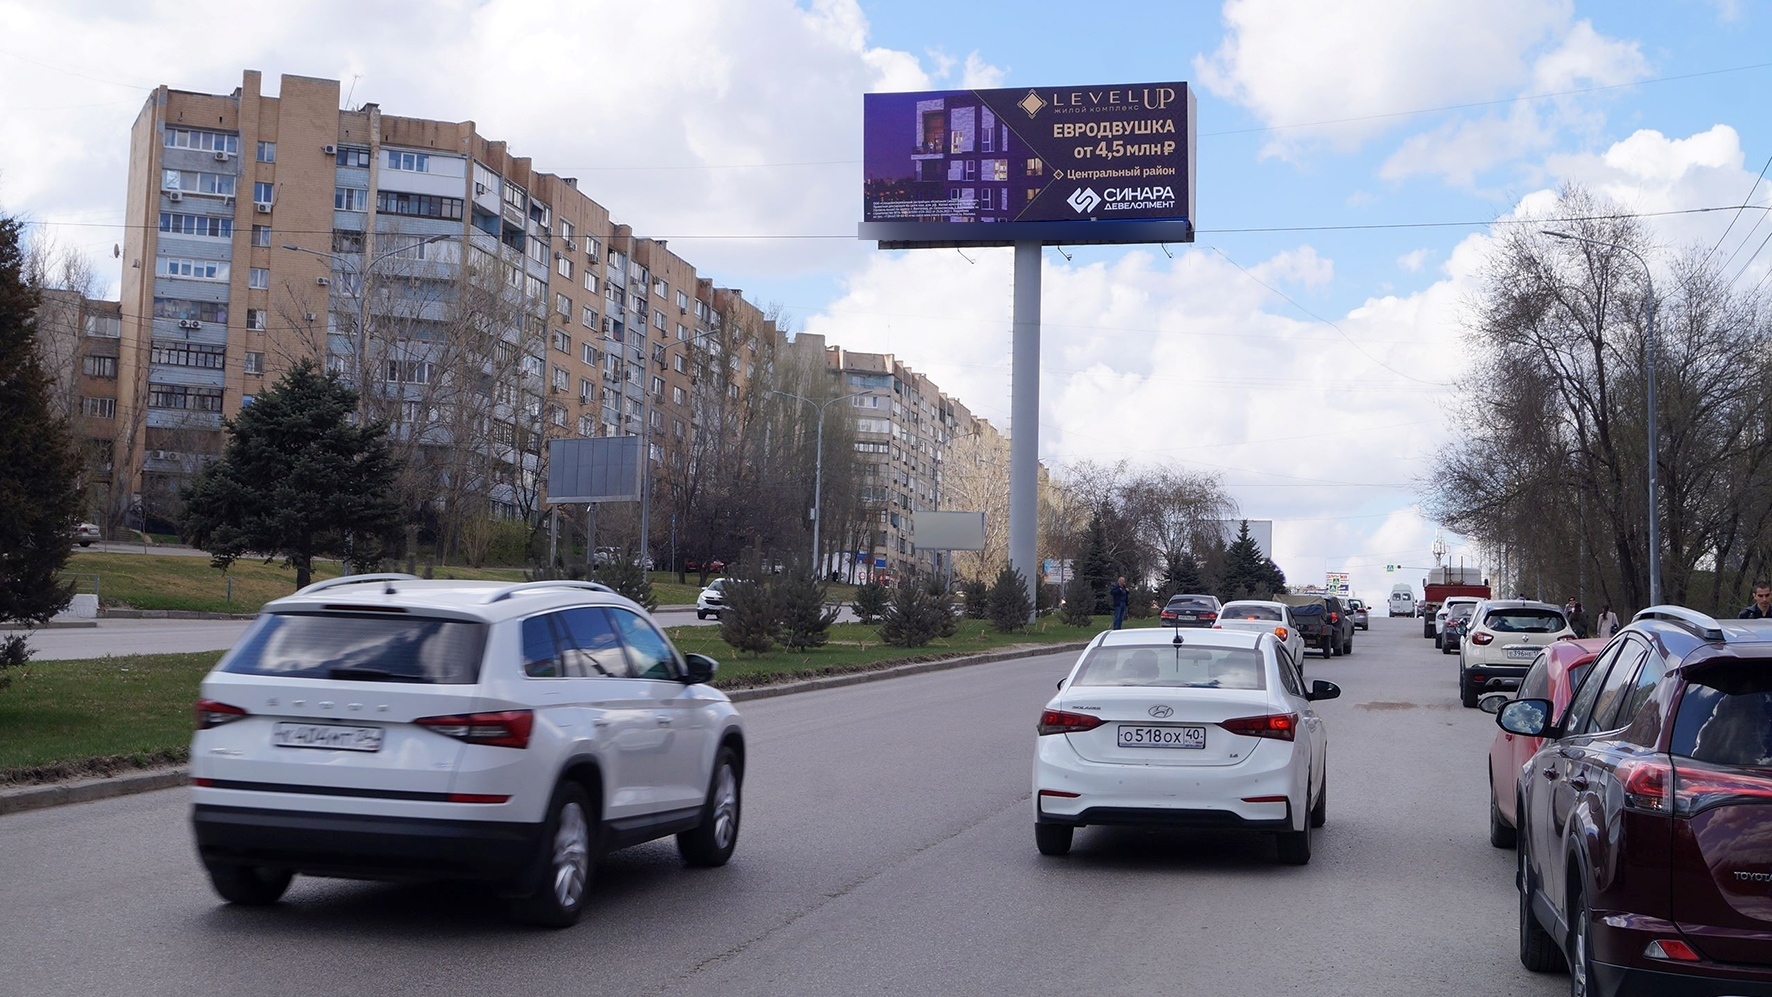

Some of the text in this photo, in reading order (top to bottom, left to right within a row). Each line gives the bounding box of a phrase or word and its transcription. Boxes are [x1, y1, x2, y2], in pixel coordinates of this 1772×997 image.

[1053, 88, 1175, 110] LEVEL UP
[1053, 119, 1176, 138] ЕВРОДВУШКА
[1074, 146, 1093, 159] от
[1095, 140, 1124, 160] 4,5
[1067, 165, 1175, 180] Центральный район
[1103, 186, 1175, 201] СИНАРА
[1104, 200, 1175, 211] ДЕВЕЛОПМЕНТ
[1186, 728, 1200, 740] 40
